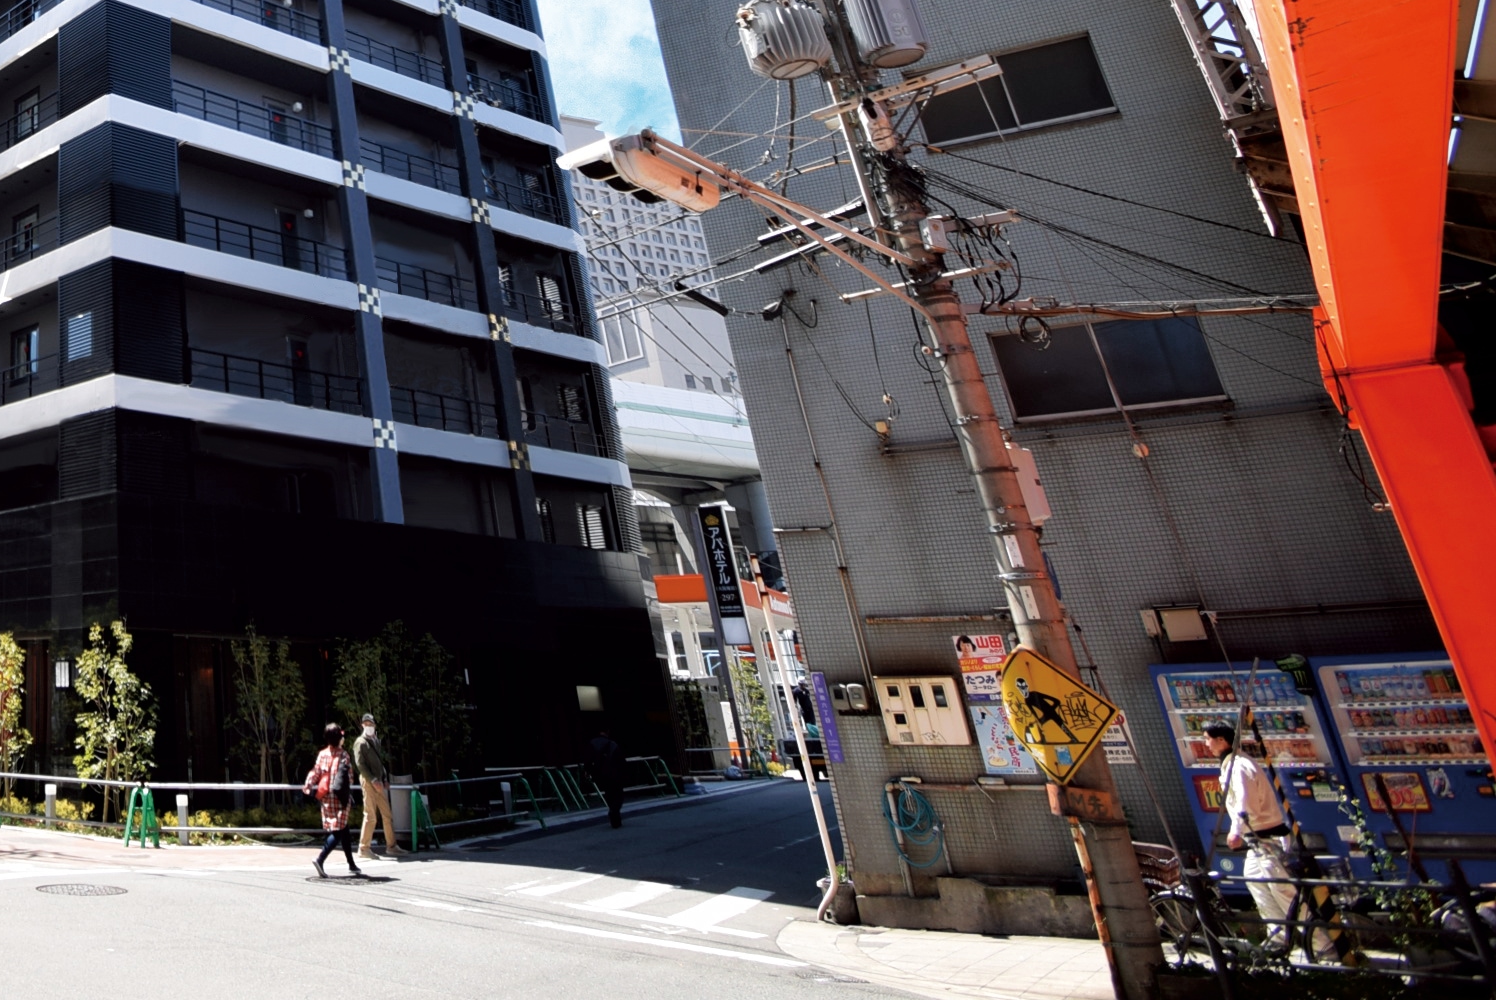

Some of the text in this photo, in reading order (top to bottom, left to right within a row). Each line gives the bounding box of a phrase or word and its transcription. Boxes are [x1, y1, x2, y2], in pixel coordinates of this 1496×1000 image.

[708, 527, 731, 584] アパホテル
[975, 636, 1002, 648] 山田
[965, 675, 995, 684] たつみ
